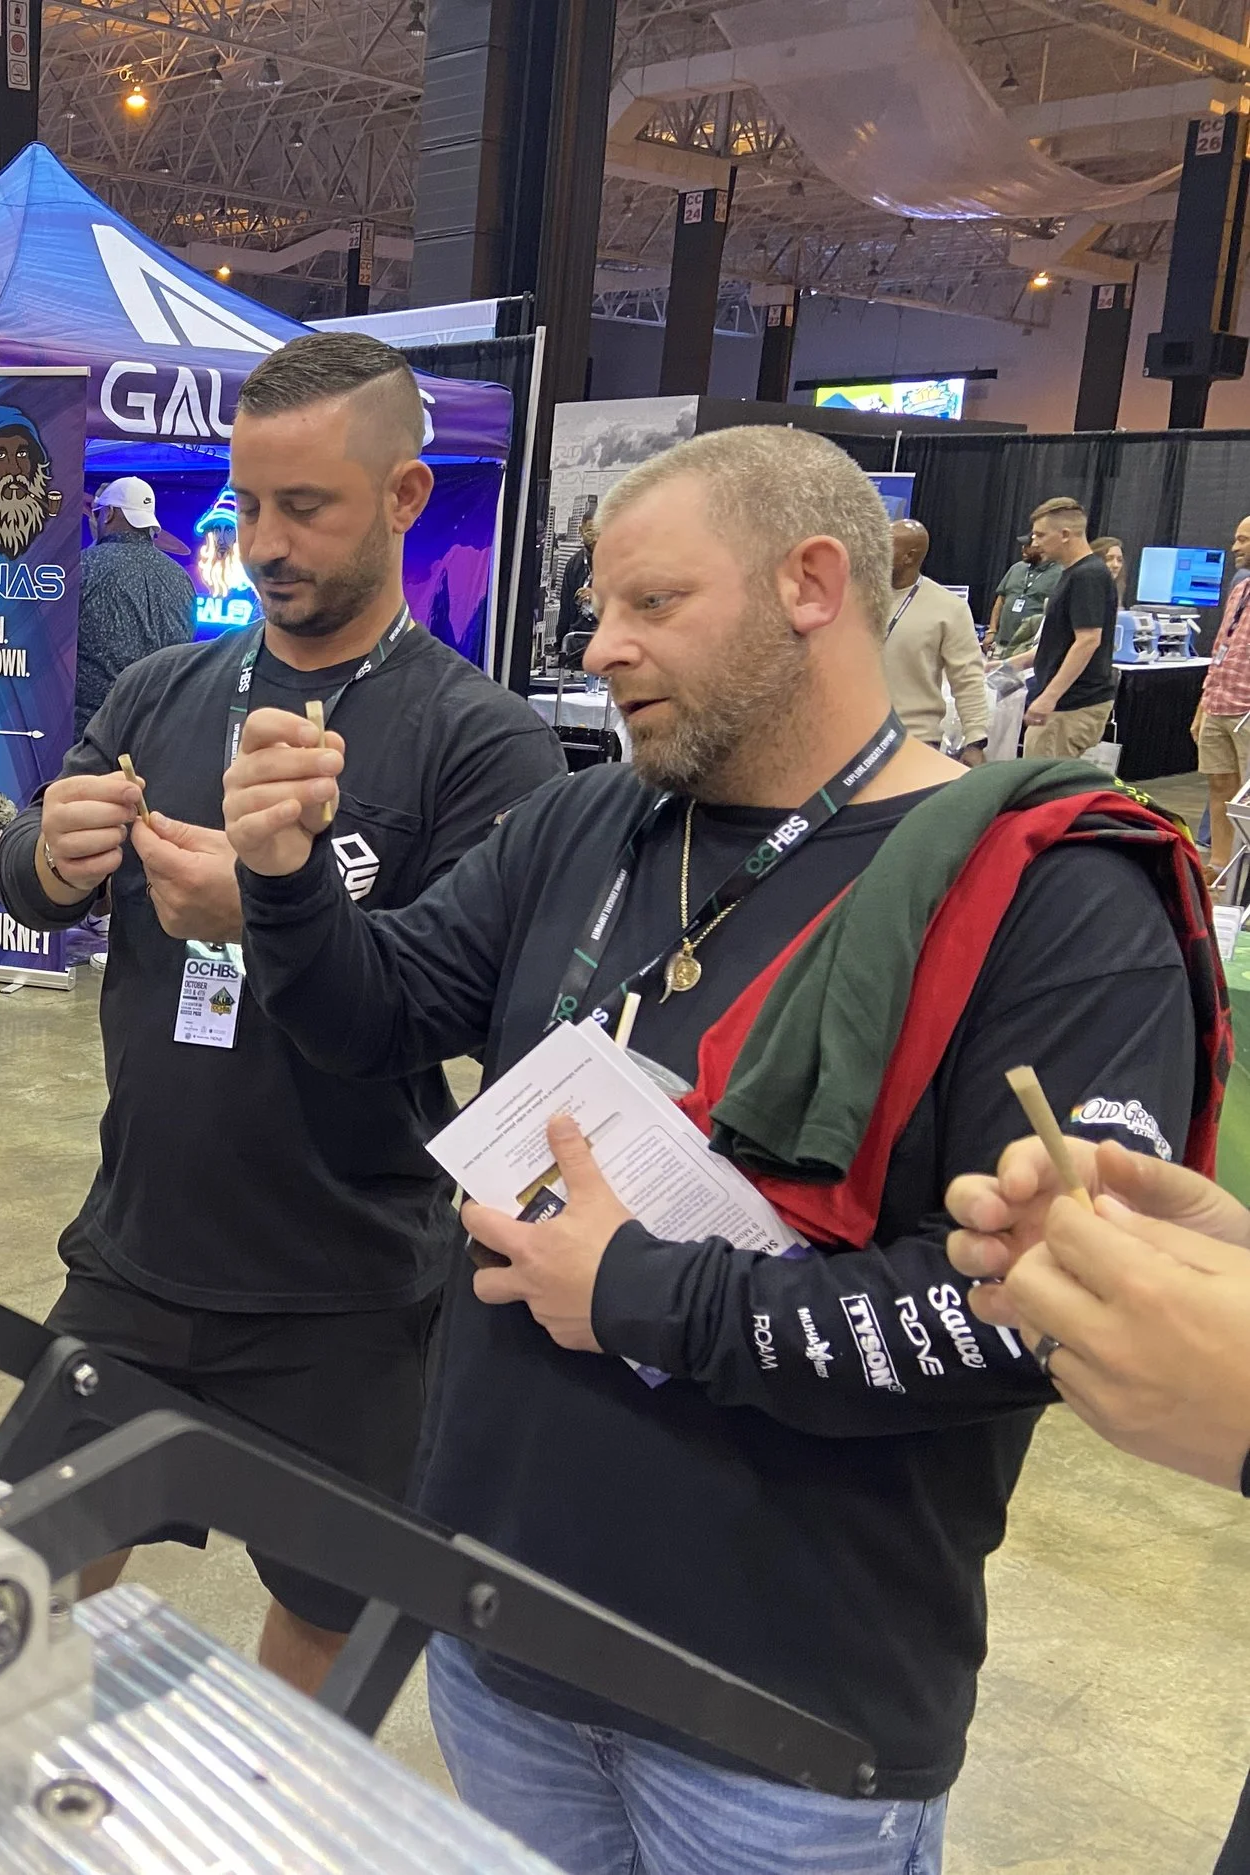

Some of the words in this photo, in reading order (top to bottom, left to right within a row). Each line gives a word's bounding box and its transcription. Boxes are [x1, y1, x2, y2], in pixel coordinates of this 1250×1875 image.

[1200, 120, 1224, 133] CC
[686, 194, 702, 206] CC
[685, 209, 701, 221] 24
[745, 815, 810, 874] OCHBS
[186, 961, 239, 979] OCHBS
[184, 980, 208, 990] OCTOBER
[1081, 1099, 1120, 1120] OLD
[927, 1283, 987, 1370] Sauce
[752, 1314, 779, 1371] ROAM
[848, 1299, 896, 1388] TYSON
